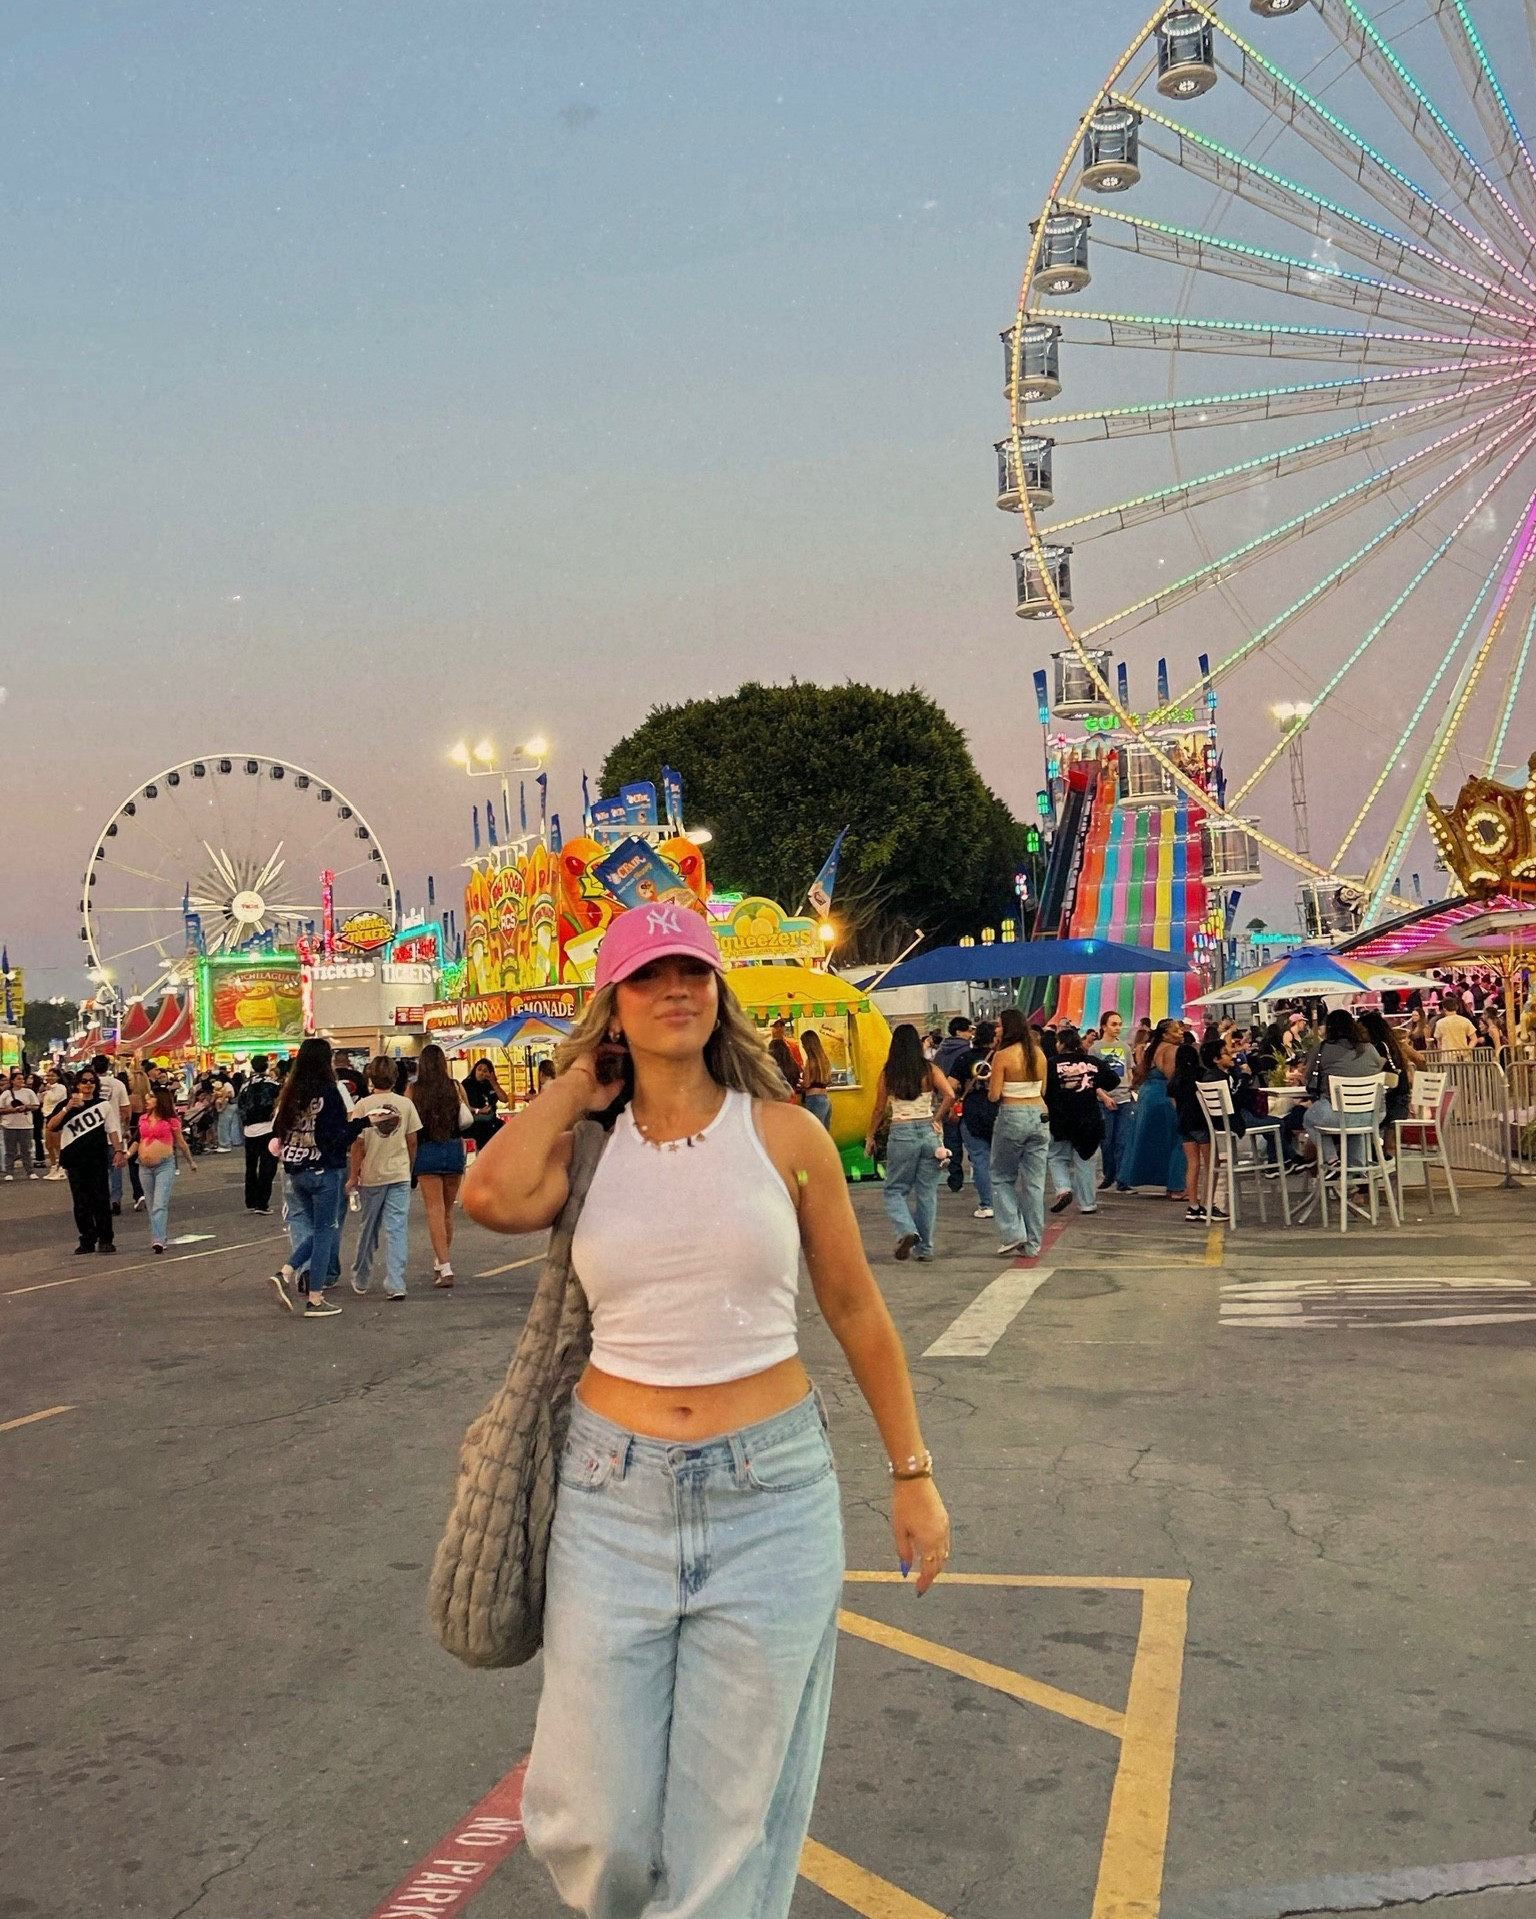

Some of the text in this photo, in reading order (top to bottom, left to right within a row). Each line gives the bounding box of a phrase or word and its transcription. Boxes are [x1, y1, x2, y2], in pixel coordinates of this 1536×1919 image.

[646, 907, 683, 935] NY
[348, 928, 391, 943] TICKETS
[311, 962, 375, 980] TICKETS
[382, 964, 432, 982] TICKETS
[463, 1001, 489, 1024] DOGS
[510, 1000, 575, 1018] LEMONADE
[454, 1816, 523, 1847] NO
